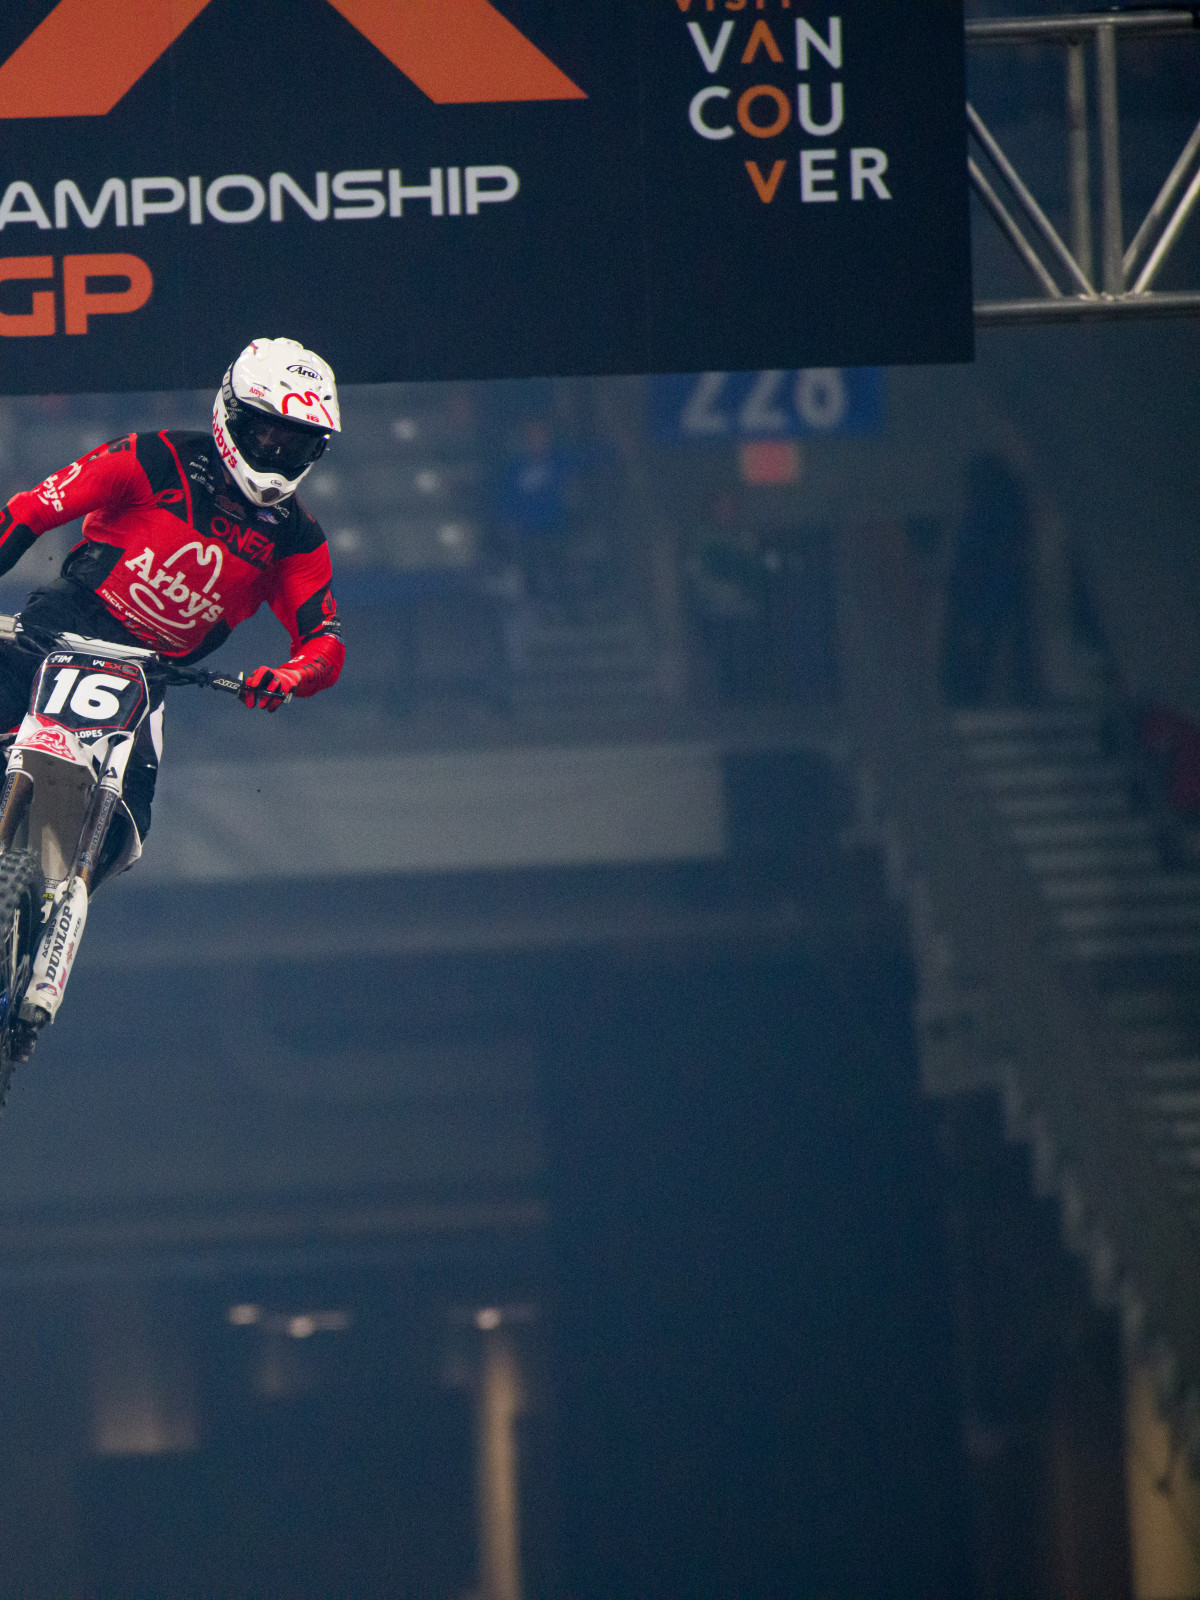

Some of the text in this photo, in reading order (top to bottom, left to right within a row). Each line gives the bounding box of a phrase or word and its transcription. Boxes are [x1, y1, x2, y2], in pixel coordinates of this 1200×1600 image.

[688, 82, 844, 140] COU
[744, 147, 893, 204] VER
[125, 547, 224, 623] Arby's
[43, 668, 130, 720] 16
[76, 729, 103, 739] LOPES
[46, 905, 73, 982] DUNLOP
